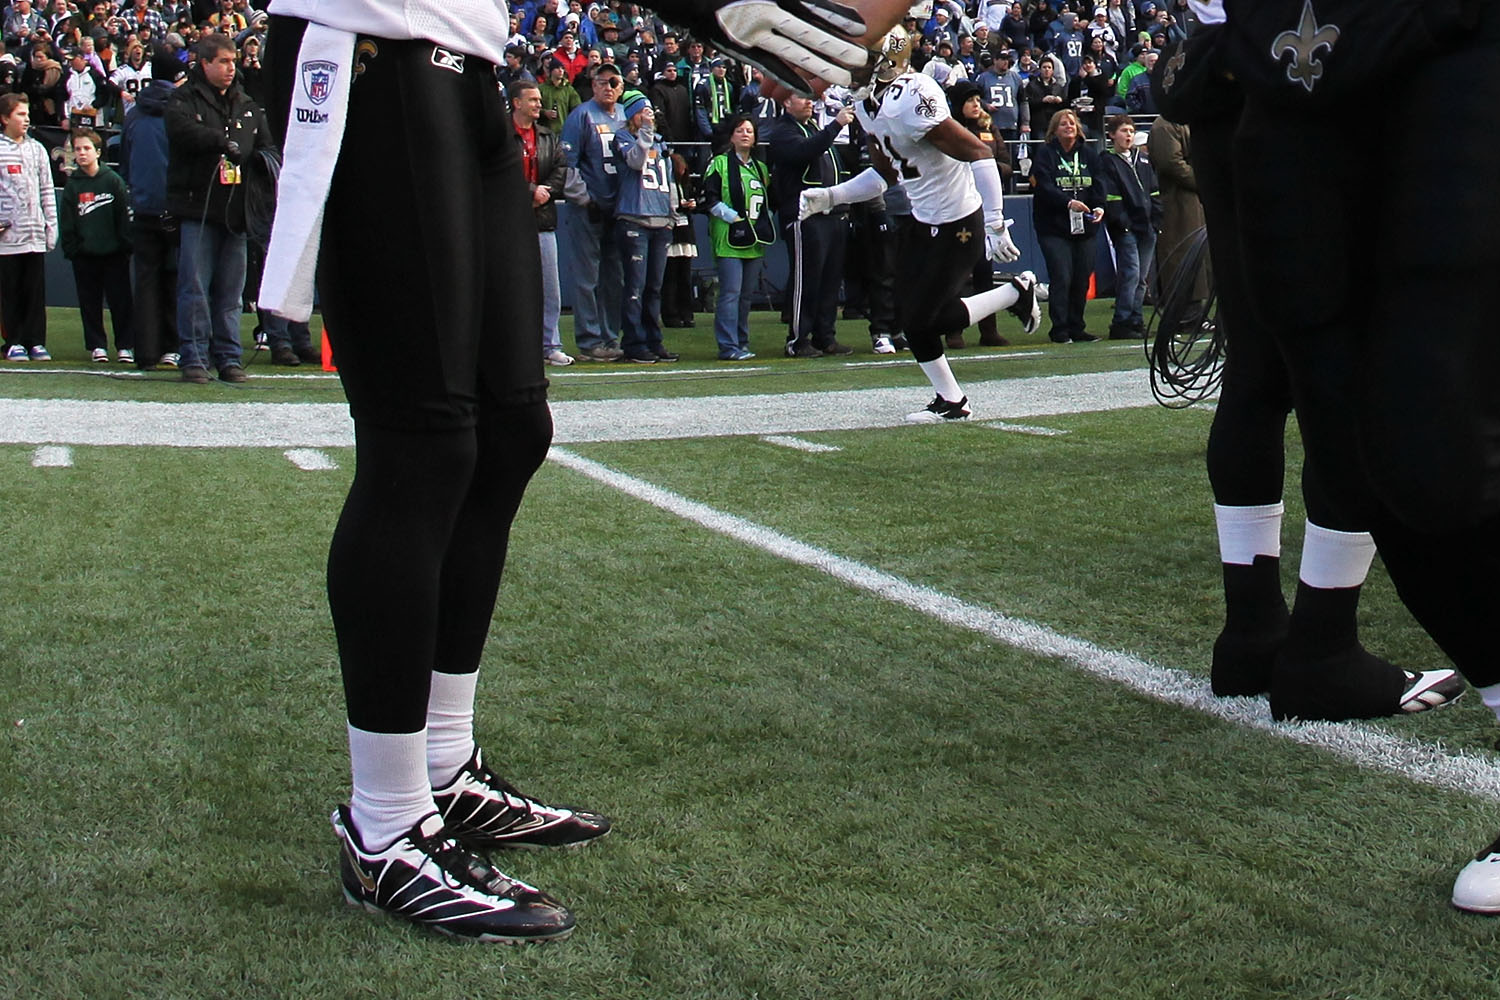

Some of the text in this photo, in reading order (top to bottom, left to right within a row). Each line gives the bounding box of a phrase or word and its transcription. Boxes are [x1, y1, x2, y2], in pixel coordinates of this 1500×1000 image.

[1067, 41, 1082, 57] 87
[990, 86, 1014, 107] 51
[296, 107, 329, 123] Wilson
[642, 157, 670, 193] 51
